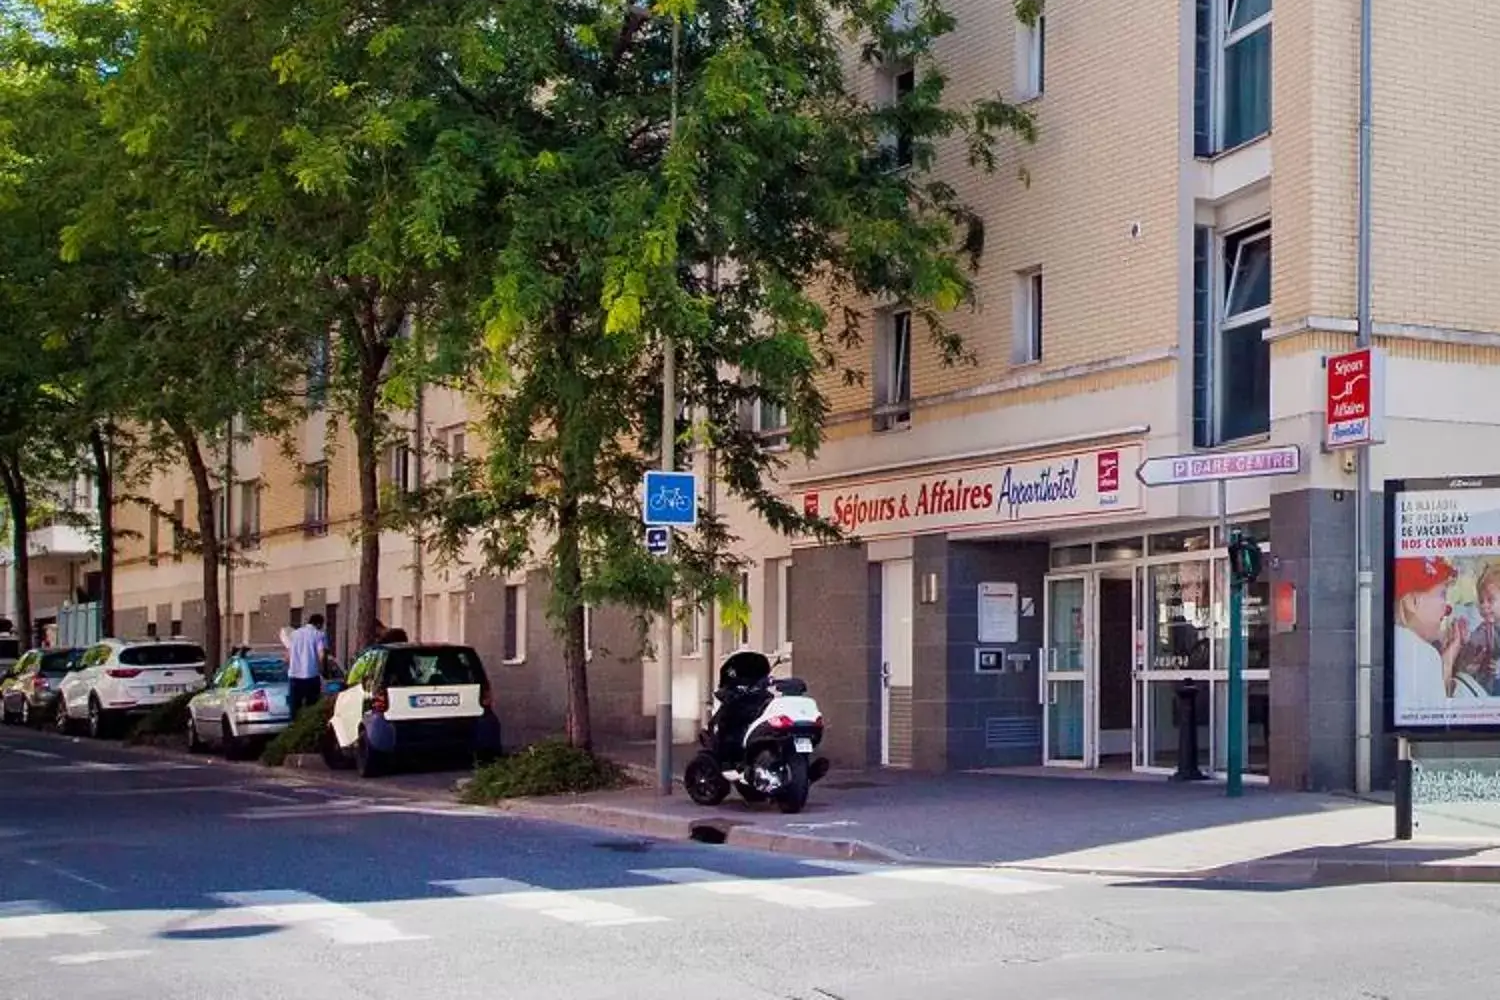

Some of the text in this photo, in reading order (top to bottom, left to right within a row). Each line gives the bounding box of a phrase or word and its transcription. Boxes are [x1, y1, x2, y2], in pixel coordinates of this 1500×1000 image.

[831, 492, 895, 530] Séjours
[899, 493, 910, 518] &
[914, 478, 993, 517] Affaires
[1451, 512, 1470, 523] PAS
[1401, 524, 1466, 538] DE VACANCES
[1401, 539, 1421, 550] NOS
[1426, 537, 1467, 549] CLOWNS
[1470, 537, 1494, 547] NON
